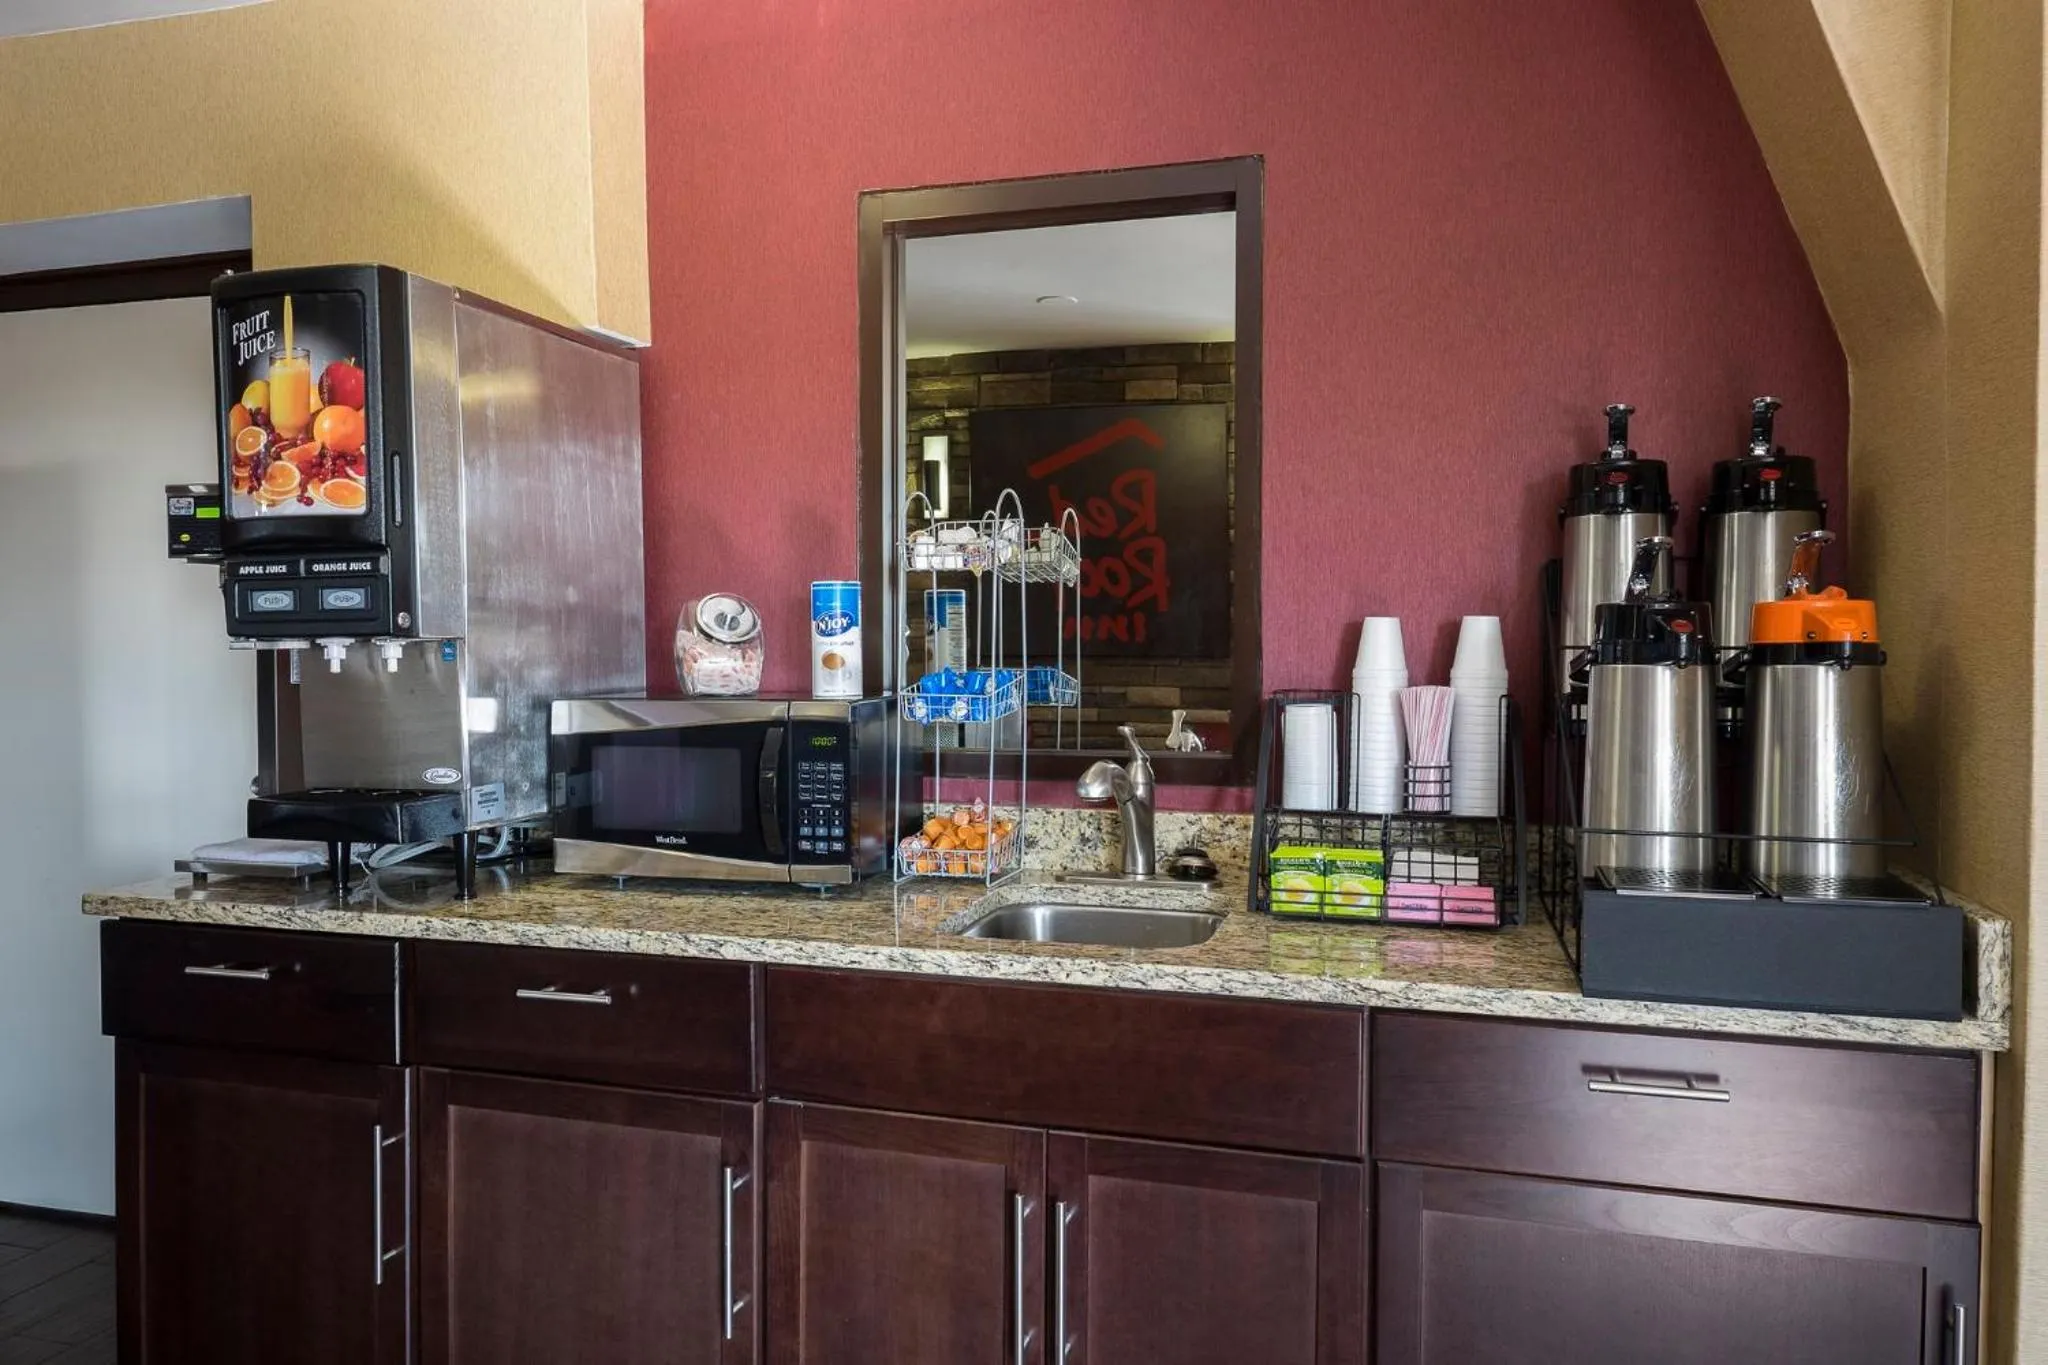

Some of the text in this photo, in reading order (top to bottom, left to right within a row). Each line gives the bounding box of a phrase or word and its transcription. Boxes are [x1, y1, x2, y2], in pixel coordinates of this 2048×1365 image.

[232, 310, 270, 346] FRUIT
[238, 331, 276, 367] JUICE
[239, 565, 287, 575] APPLE JUICE
[312, 562, 372, 572] ORANGE JUICE
